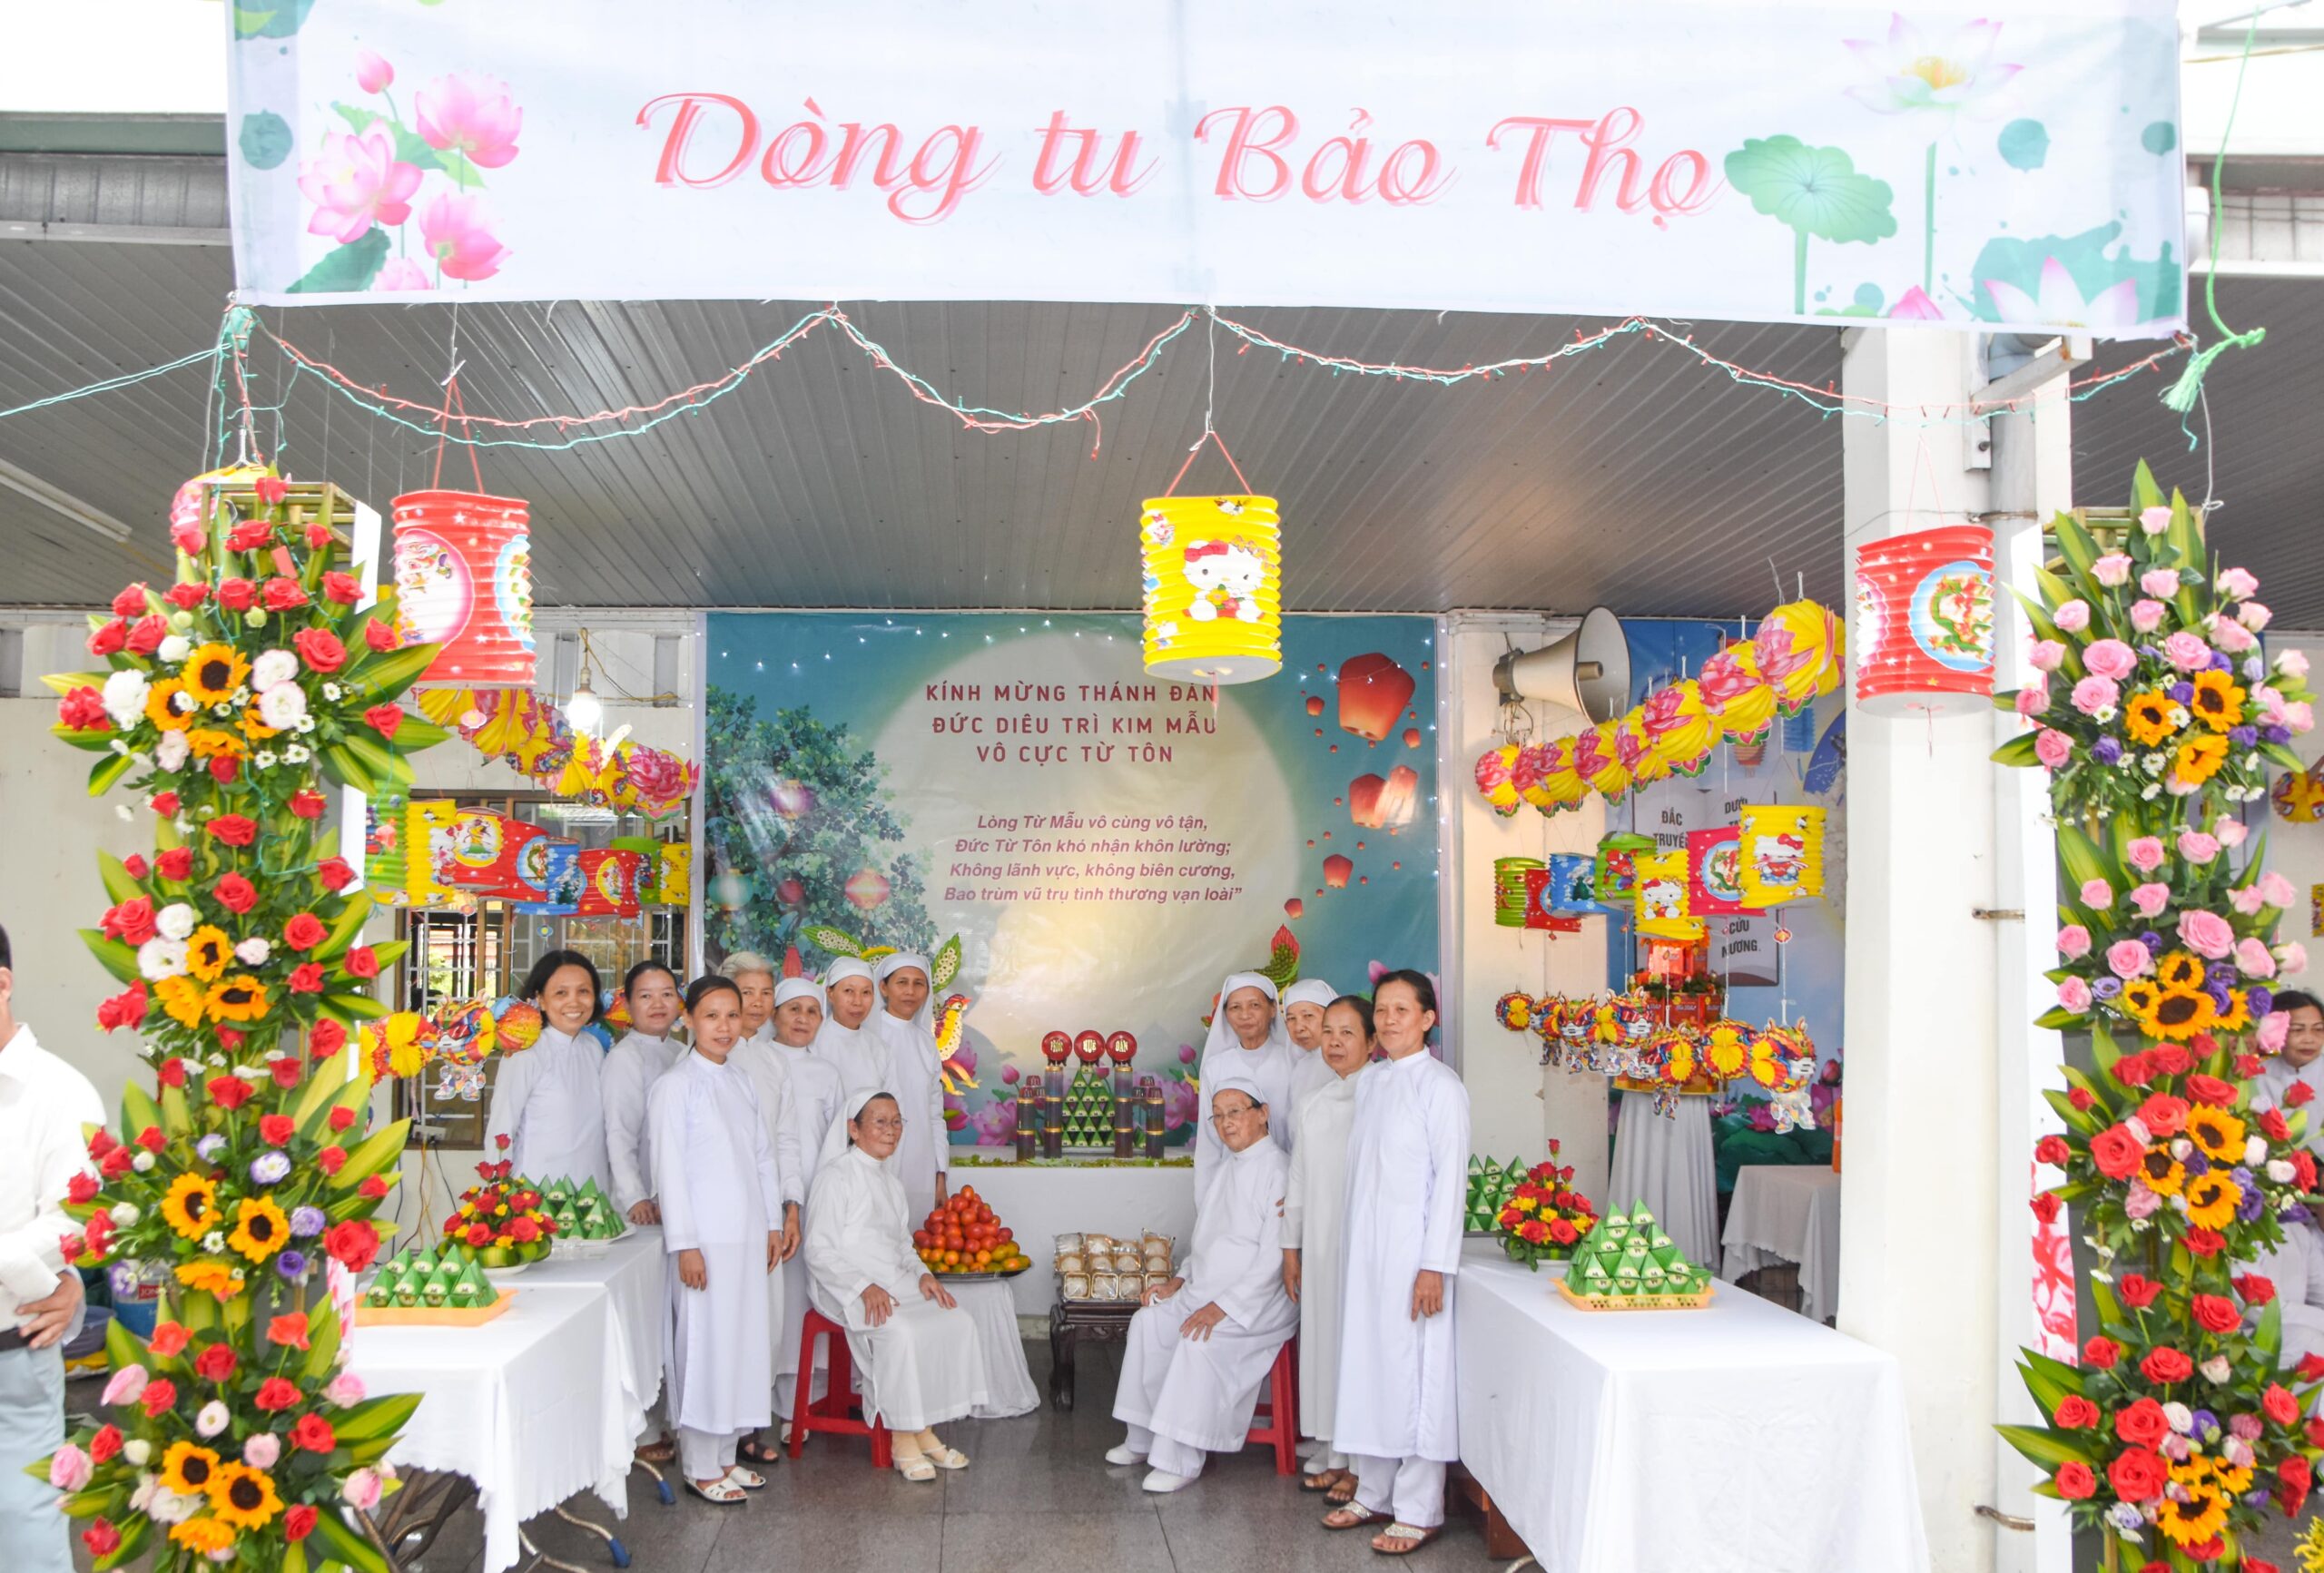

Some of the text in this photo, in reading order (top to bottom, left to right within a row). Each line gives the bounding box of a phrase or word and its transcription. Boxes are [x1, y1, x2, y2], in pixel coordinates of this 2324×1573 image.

[635, 93, 1728, 231] Dòng tu Bảo Thọ
[927, 680, 980, 701] KÍNH
[995, 680, 1065, 702] MỪNG
[1078, 681, 1156, 702] THÁNH
[932, 711, 1216, 733] ĐỨC DIÊU TRÌ KIM MẪU
[977, 742, 1171, 767] VÔ CỰC TỪ TÔN
[978, 811, 1206, 831] Lòng Từ Mẫu vô cùng vô tận,
[955, 839, 990, 852] Đức
[995, 839, 1019, 852] Từ
[1022, 839, 1051, 852] Tôn
[1090, 839, 1129, 856] nhận
[1135, 839, 1174, 852] khôn
[1178, 839, 1231, 856] lường;
[950, 863, 1002, 880] Không
[1007, 863, 1040, 876] lãnh
[1085, 863, 1135, 880] không
[1178, 865, 1235, 880] cương,
[944, 888, 976, 900] Bao
[981, 888, 1018, 900] trùm
[1024, 888, 1041, 900] vũ
[1047, 889, 1068, 903] trụ
[1109, 888, 1167, 904] thương
[1173, 890, 1199, 904] vạn
